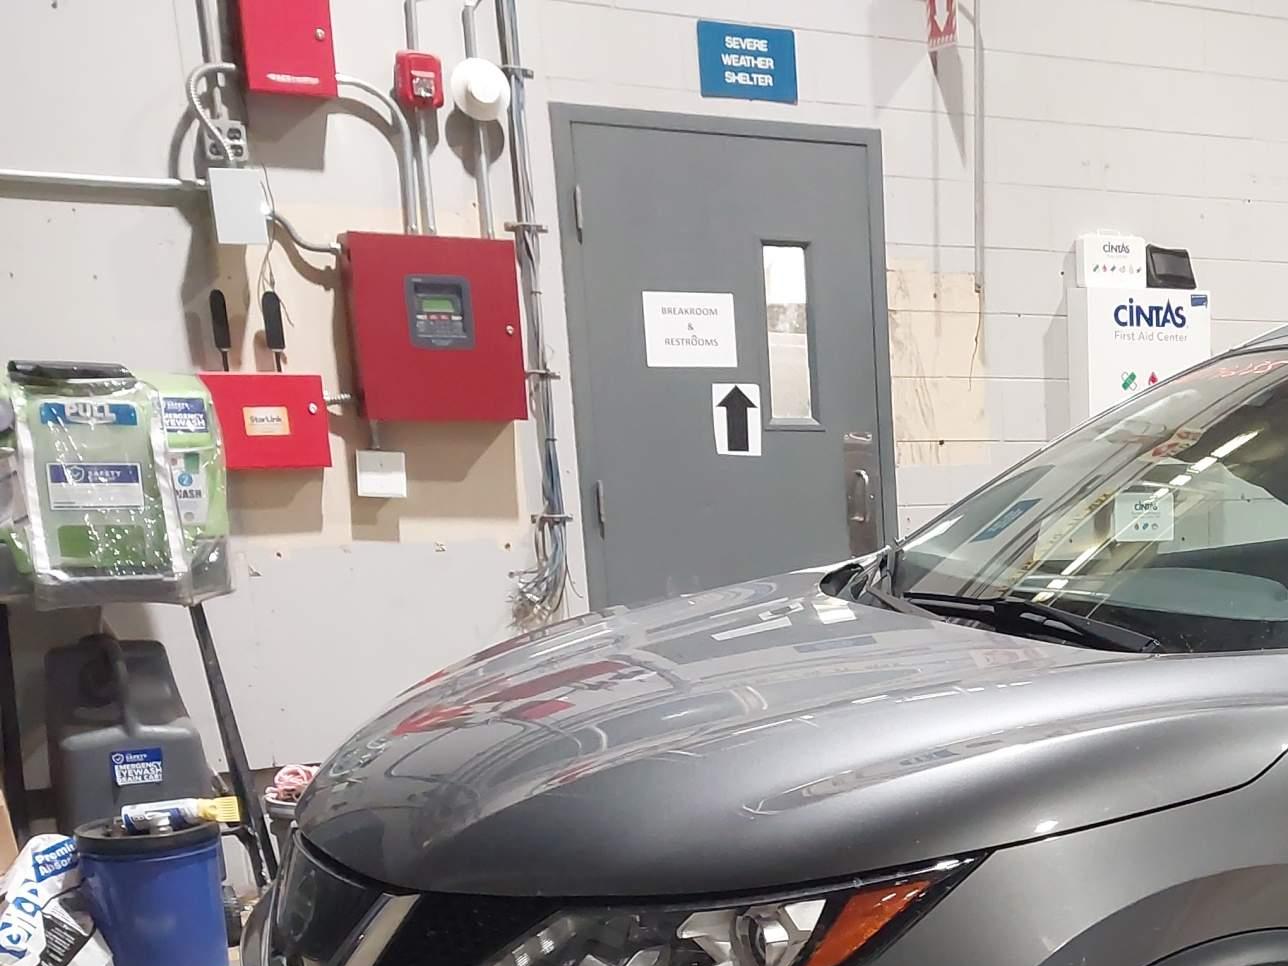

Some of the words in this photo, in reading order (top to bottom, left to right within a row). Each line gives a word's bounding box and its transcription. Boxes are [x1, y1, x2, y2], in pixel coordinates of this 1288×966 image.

[724, 36, 768, 52] SEVERE
[721, 53, 774, 70] WEATHER
[724, 71, 773, 87] SHELTER
[1103, 242, 1130, 253] CINTAS
[661, 306, 719, 316] BREAKROOM
[1113, 297, 1187, 329] CINTAS
[687, 322, 695, 331] &
[664, 337, 719, 347] RESTROOMS
[1114, 330, 1135, 341] First
[1138, 331, 1154, 341] Aid
[1157, 331, 1188, 342] Center
[65, 401, 116, 421] PULL
